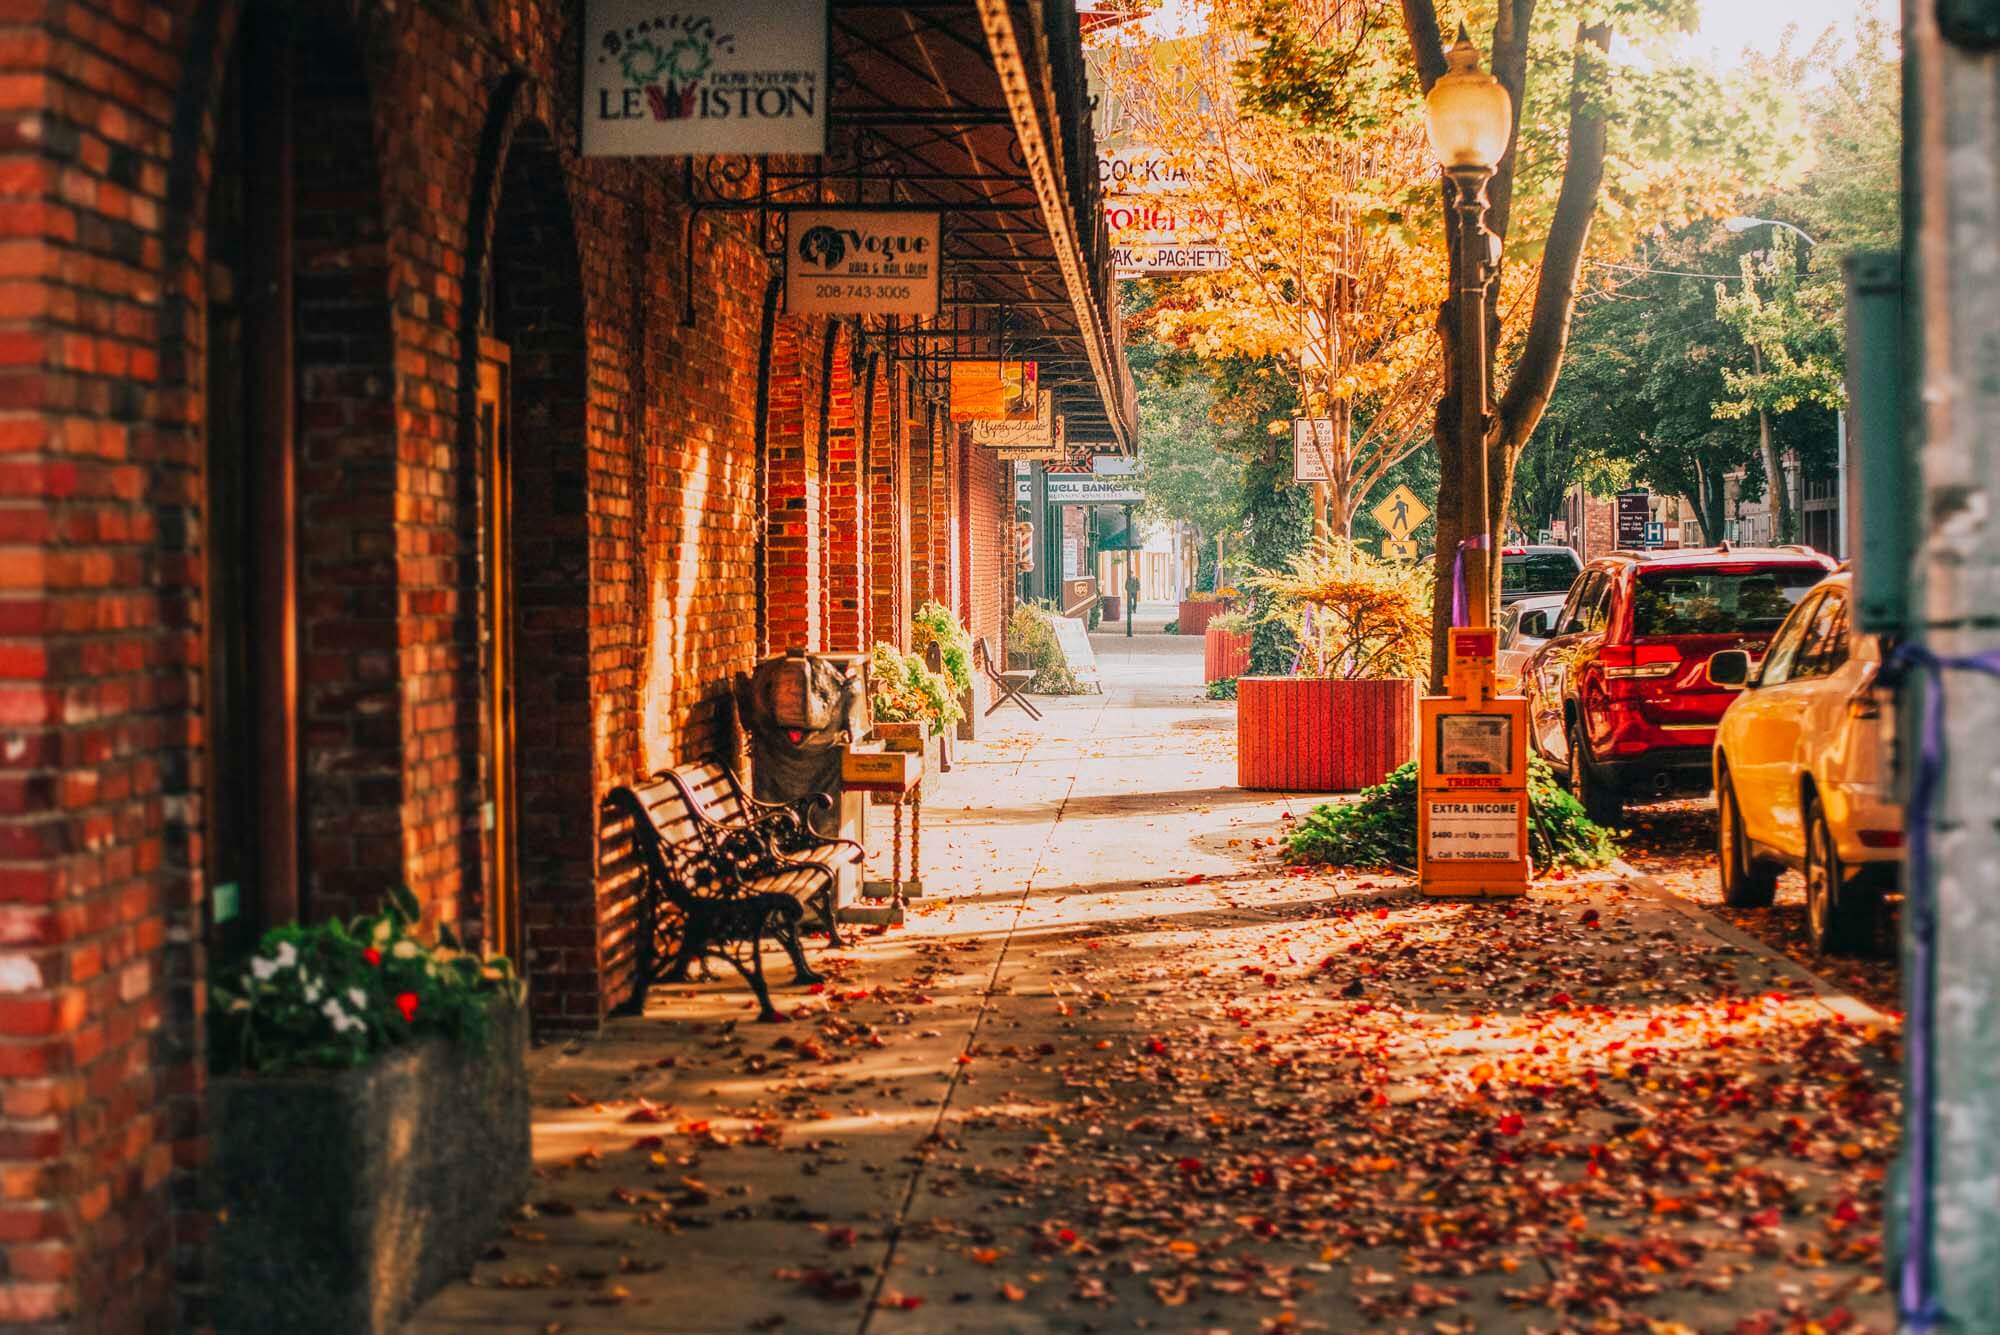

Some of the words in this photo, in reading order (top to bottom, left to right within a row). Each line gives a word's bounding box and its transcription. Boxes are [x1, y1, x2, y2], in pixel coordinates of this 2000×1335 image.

[599, 81, 816, 121] LEWISTON
[1099, 159, 1216, 182] COCKAS
[849, 229, 930, 261] Vogue
[1019, 483, 1078, 493] COWELL
[1648, 524, 1661, 539] H
[1432, 804, 1469, 813] EXTRA
[1472, 804, 1516, 813] INCOME
